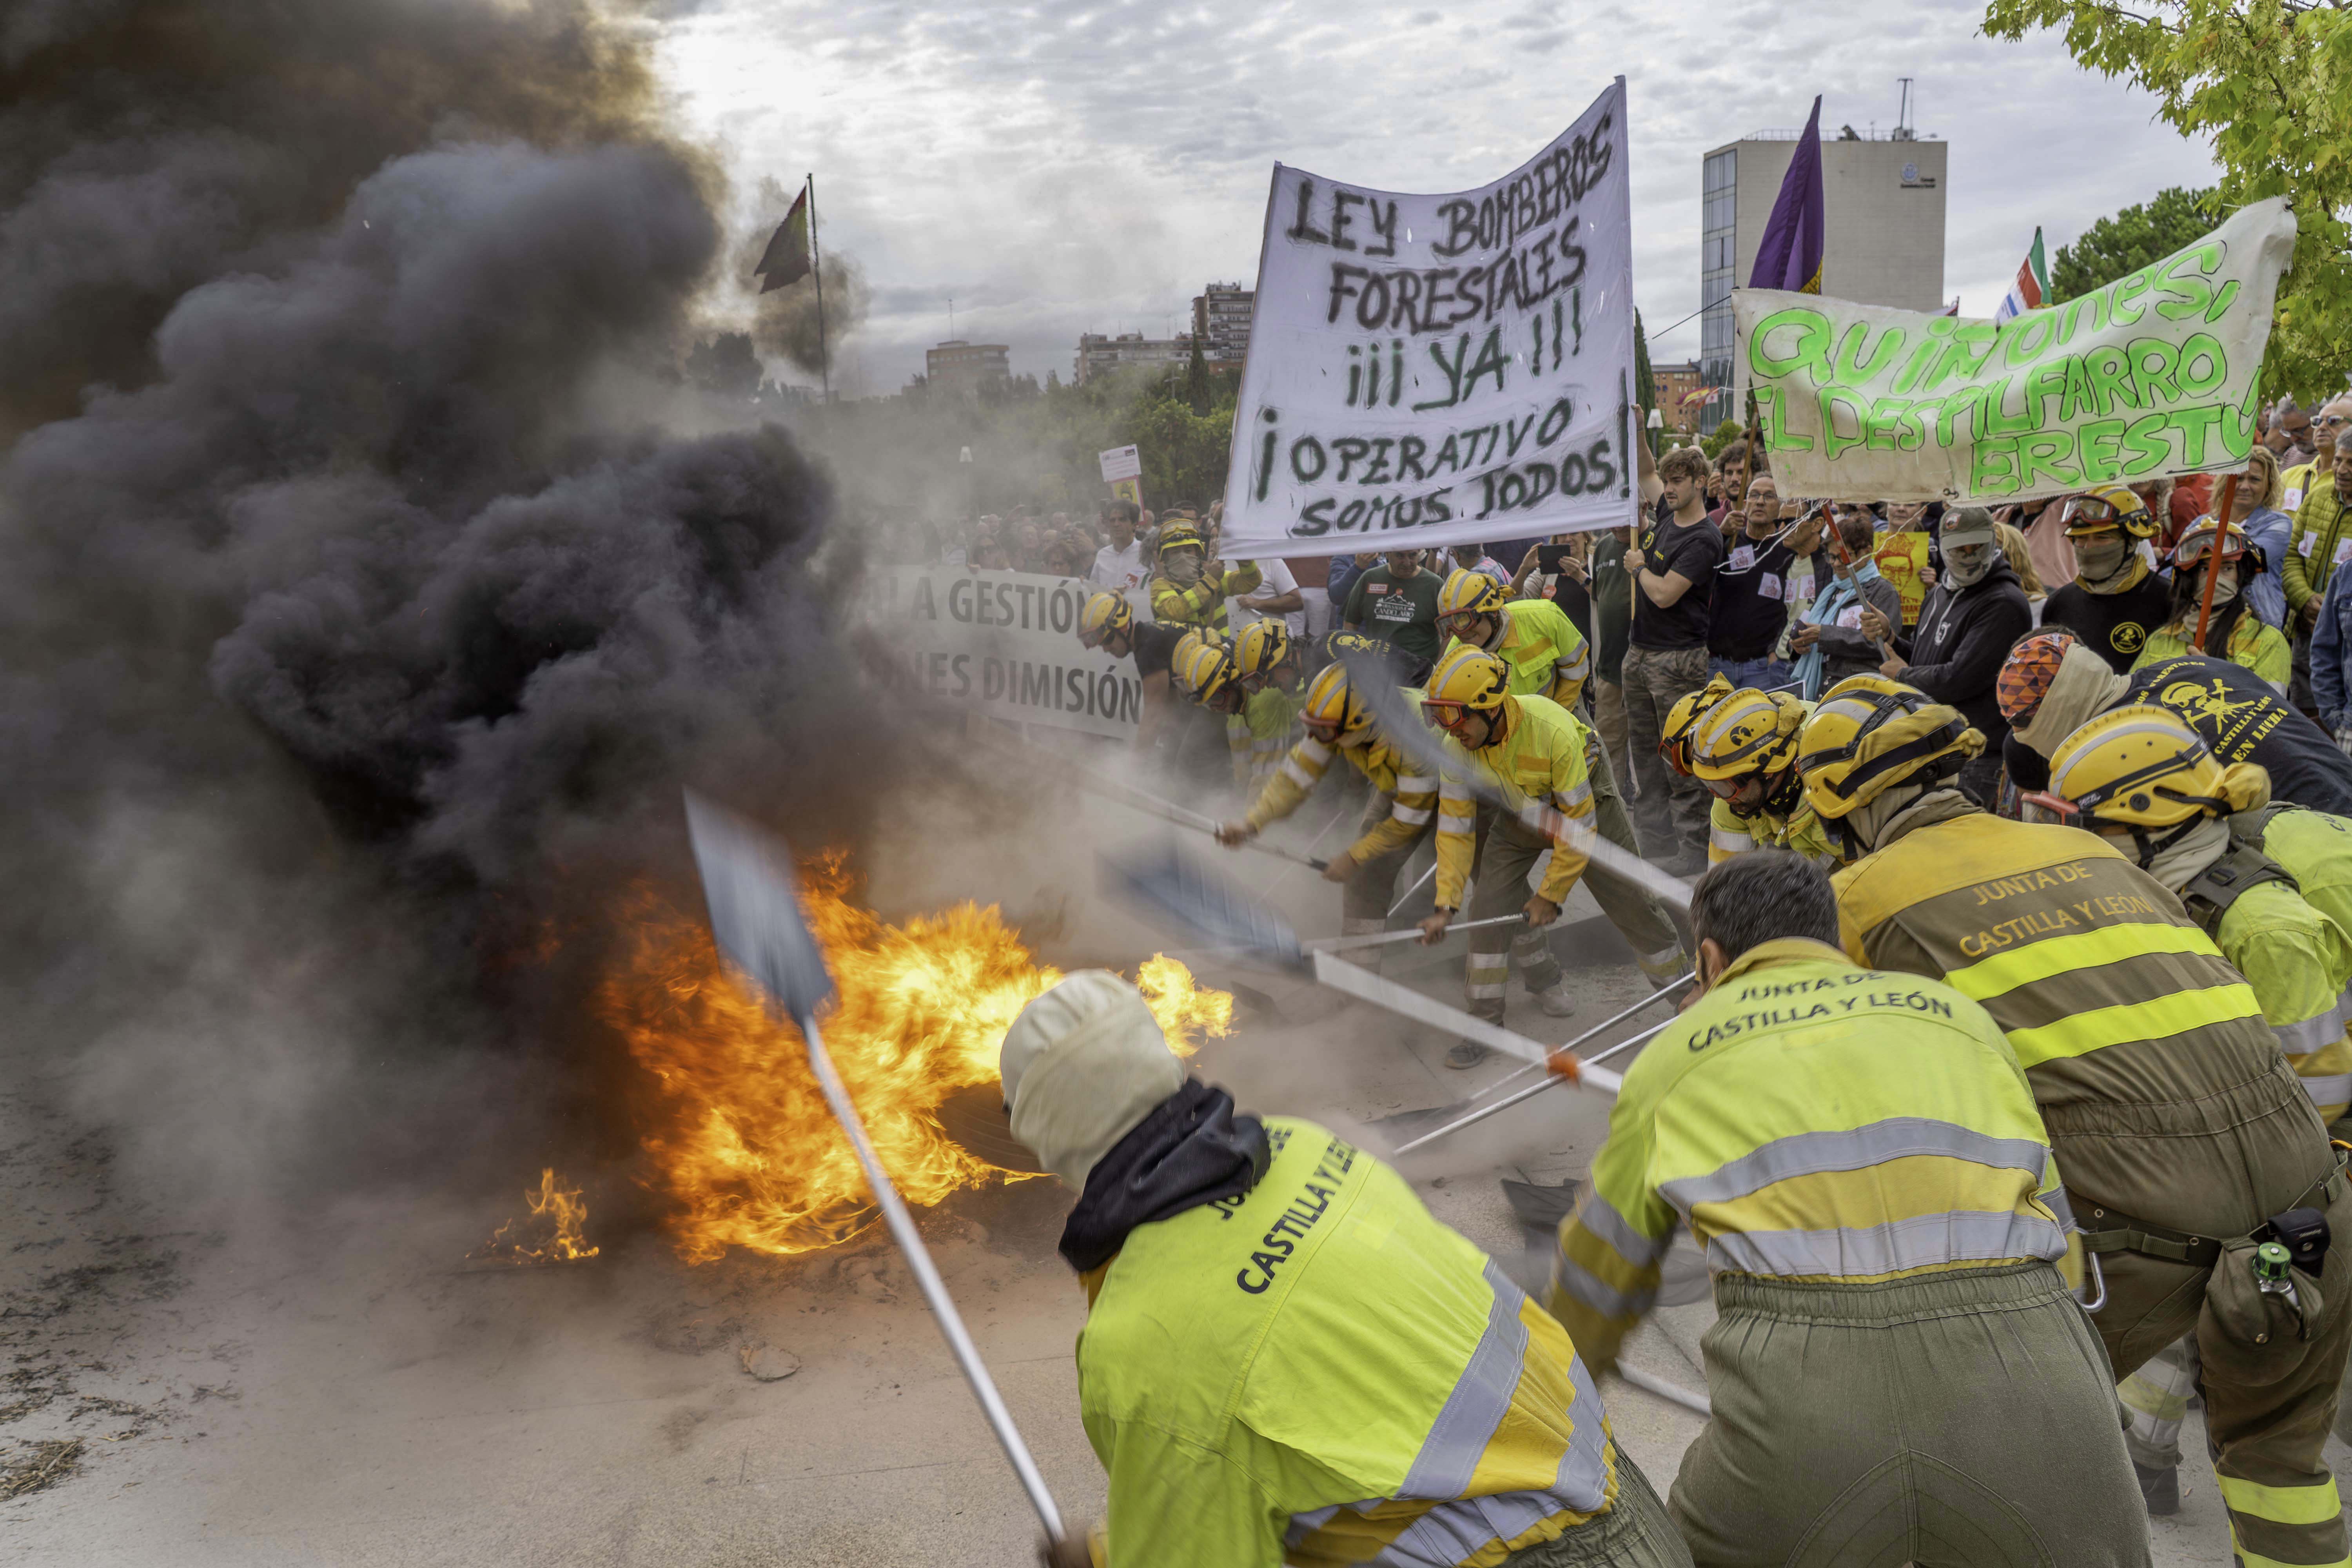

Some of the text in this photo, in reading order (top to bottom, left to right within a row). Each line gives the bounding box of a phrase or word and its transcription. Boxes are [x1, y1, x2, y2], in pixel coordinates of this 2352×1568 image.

[1286, 112, 1613, 257] LEY BOMBEROS
[1328, 216, 1587, 335] FORESTALES
[1815, 332, 2227, 462] DESPILFARRO
[983, 657, 1142, 725] DIMISIÓN
[2214, 714, 2252, 755] CASTILLA
[2230, 707, 2288, 762] EN LUCHA
[1972, 861, 2094, 906] JUNTA DE
[1959, 891, 2154, 958] CASTILLA Y LEÓN
[1735, 970, 1886, 1003] JUNTA DE
[1687, 991, 1953, 1052] CASTILLA Y LEÓN
[1237, 1182, 1336, 1294] CASTILLA
[1313, 1164, 1343, 1187] Y
